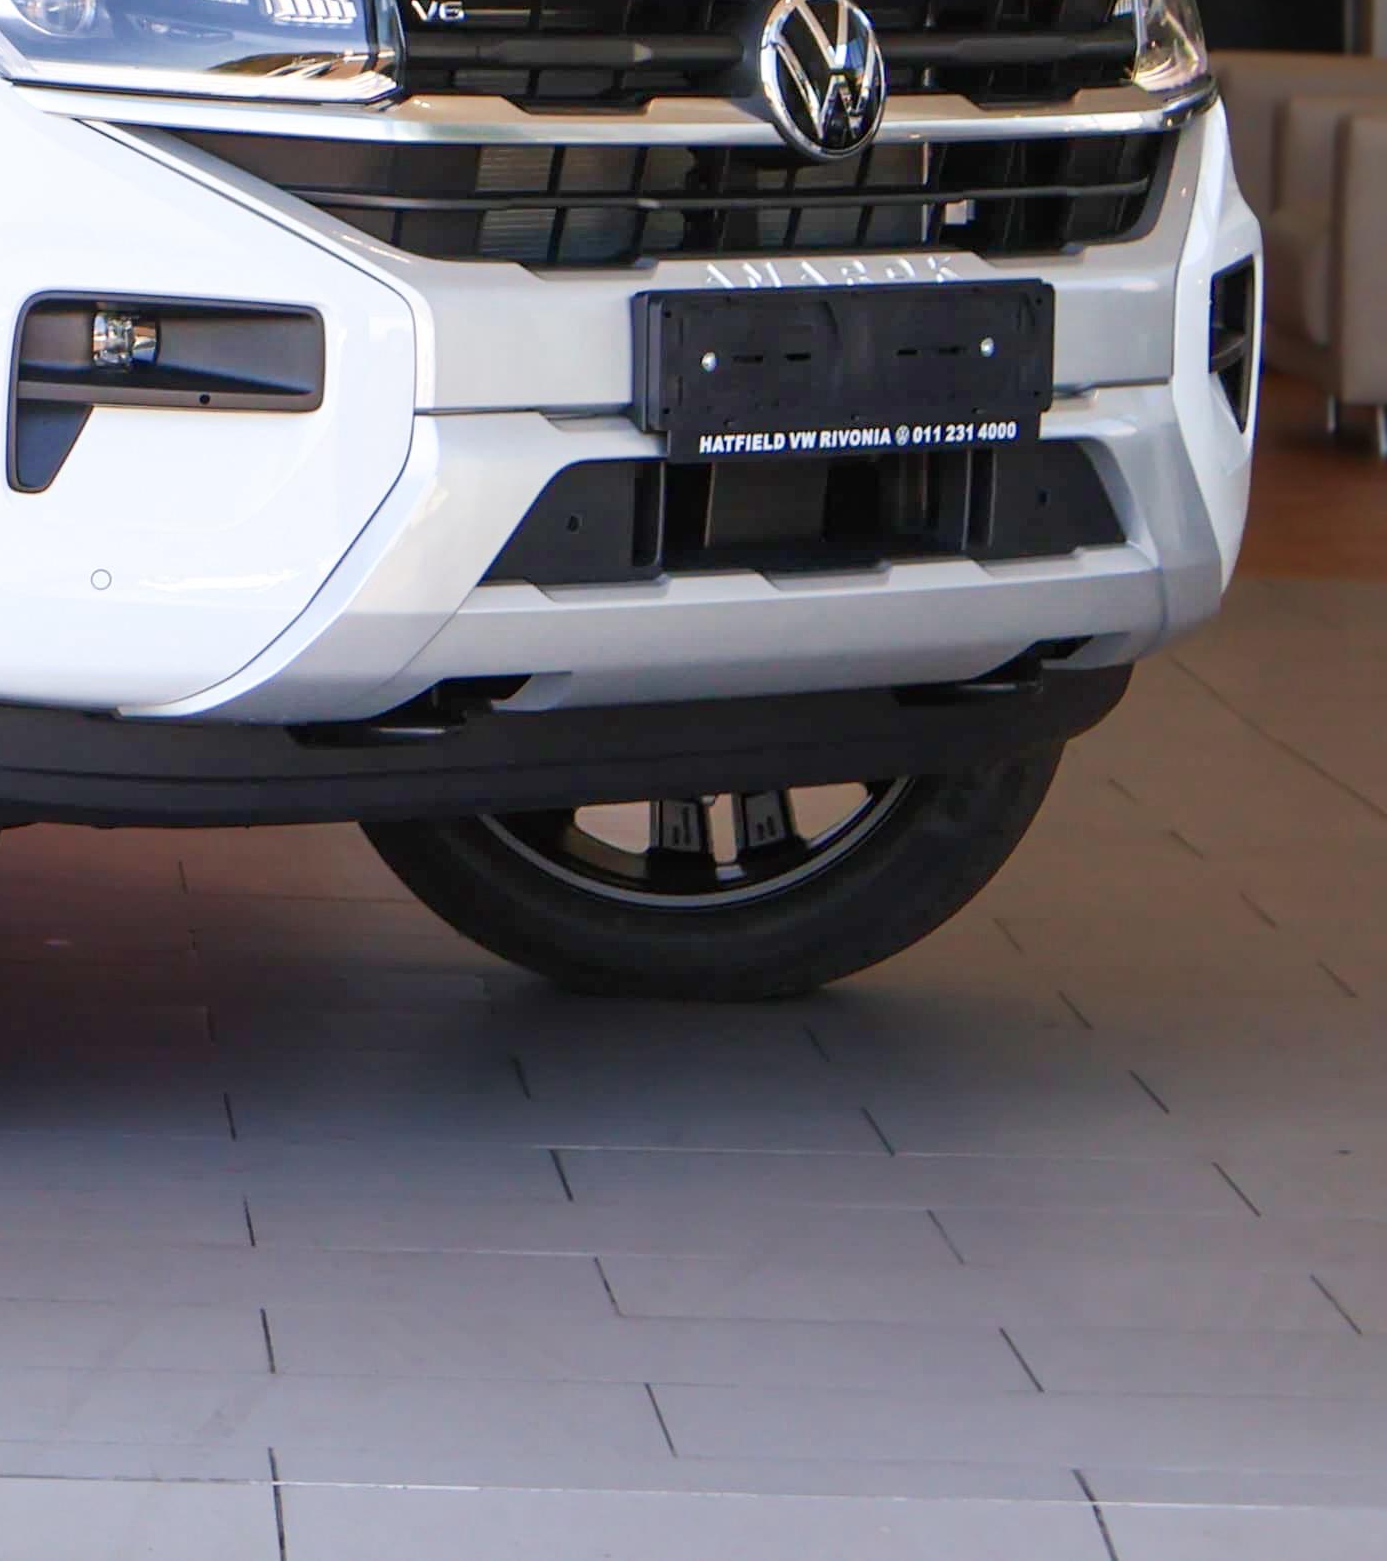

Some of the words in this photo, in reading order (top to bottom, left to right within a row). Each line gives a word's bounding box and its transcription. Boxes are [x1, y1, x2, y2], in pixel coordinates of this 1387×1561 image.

[699, 432, 785, 453] HATFIELD
[788, 431, 818, 450] VW
[819, 428, 891, 449] RIVONIA
[912, 425, 941, 444] 011
[944, 423, 973, 442] 231
[977, 421, 1017, 440] 4000
